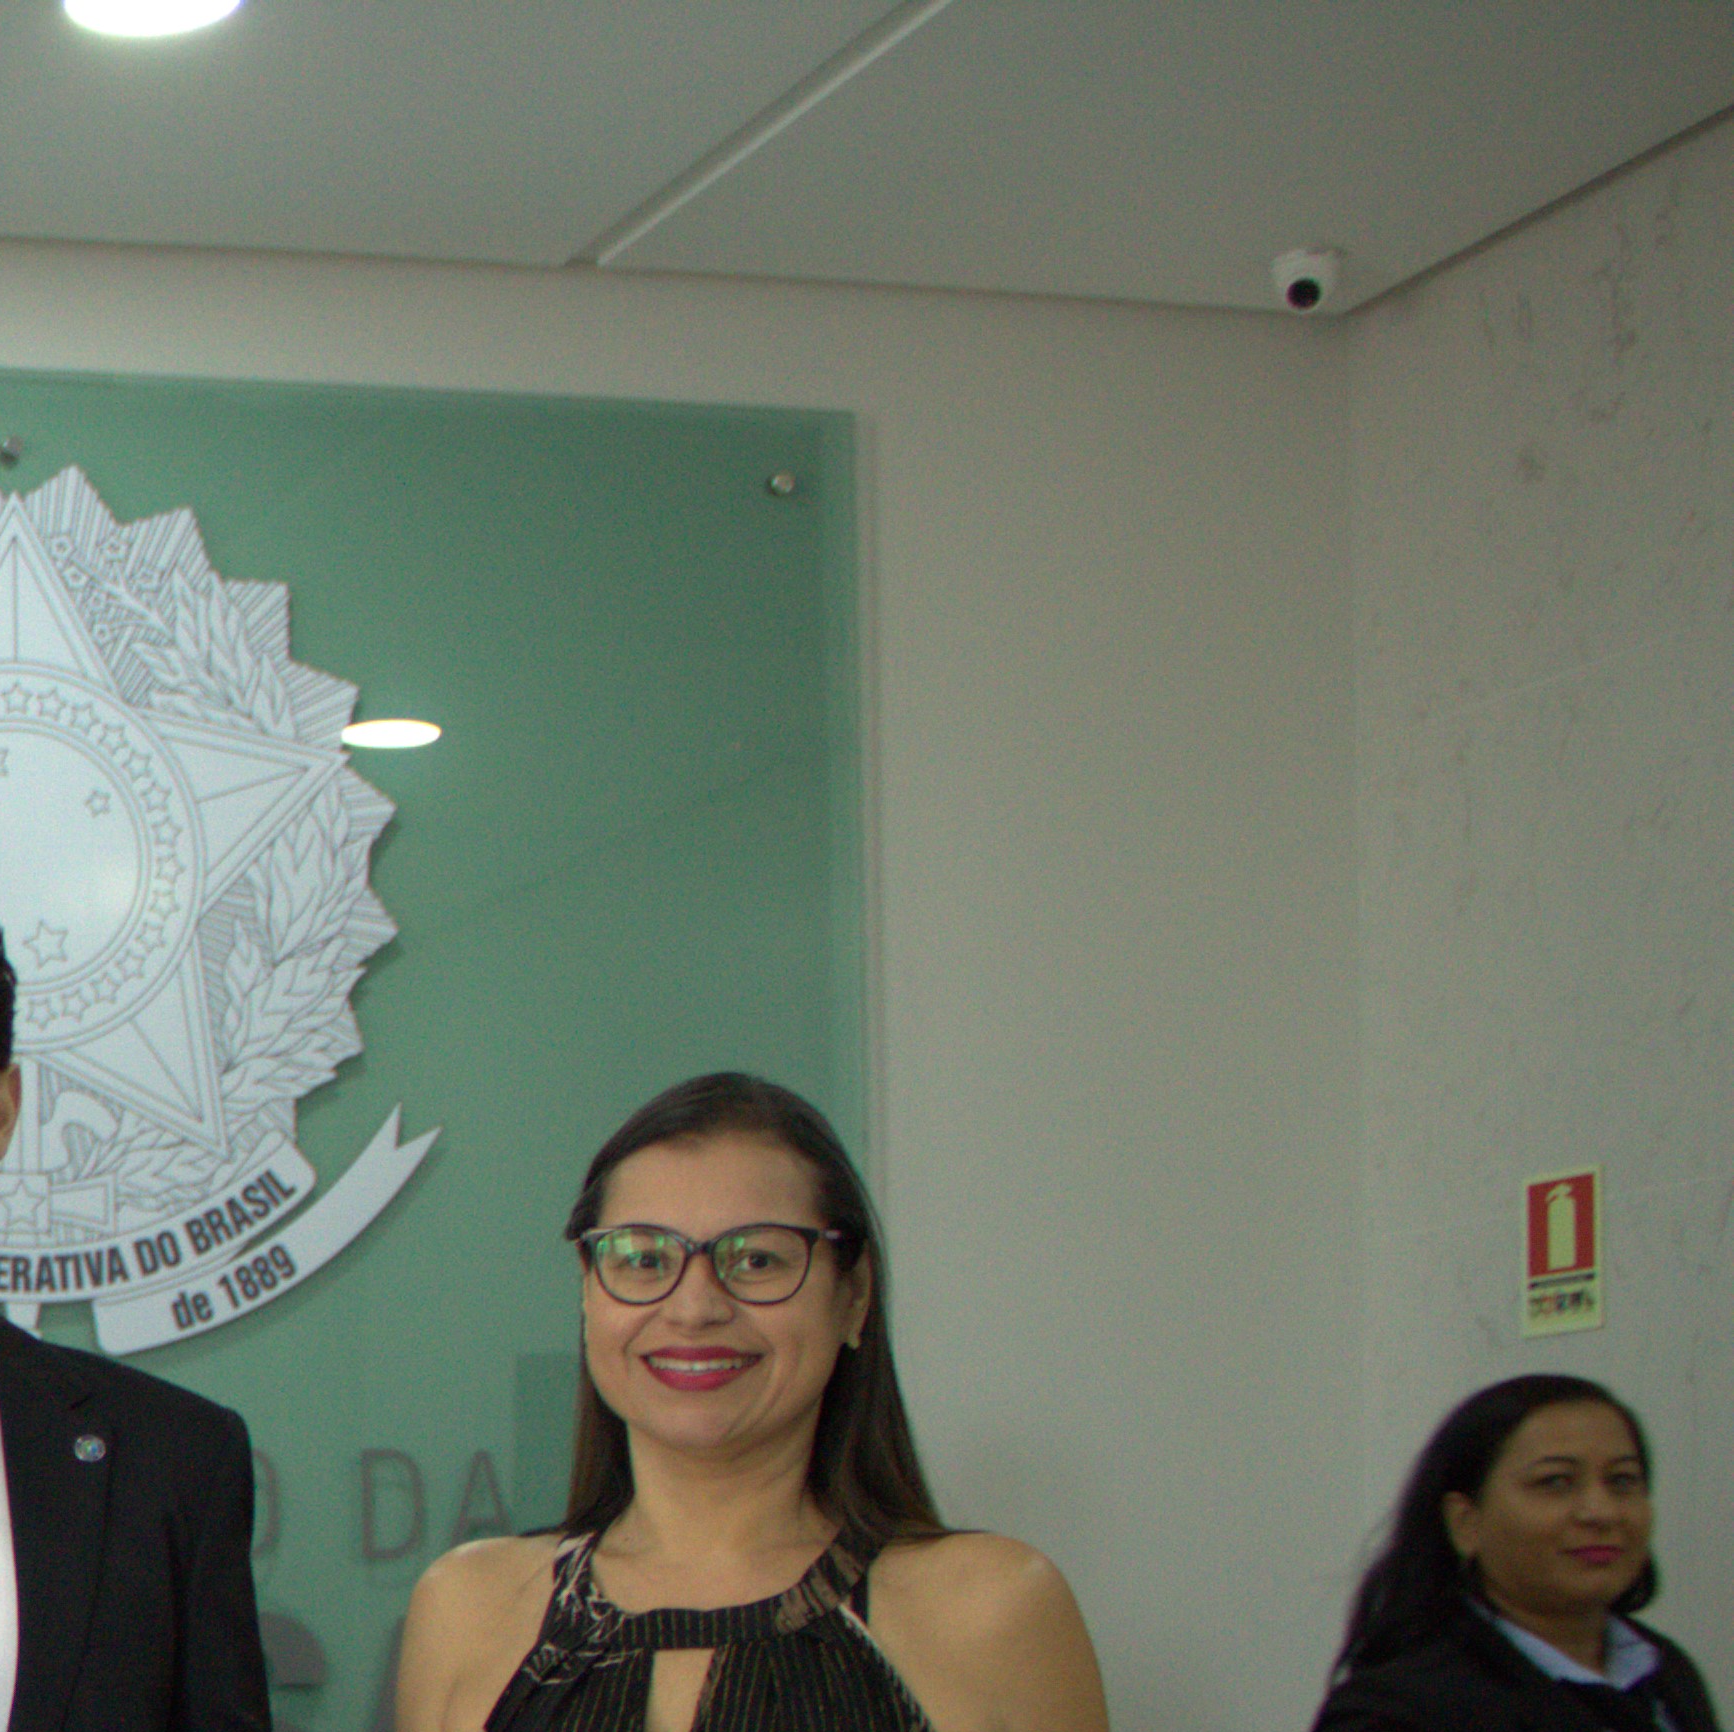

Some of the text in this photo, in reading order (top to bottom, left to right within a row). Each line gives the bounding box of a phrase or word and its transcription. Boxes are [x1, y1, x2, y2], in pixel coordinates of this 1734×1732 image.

[133, 1229, 182, 1276] DO
[185, 1169, 296, 1255] BRASIL
[171, 1244, 298, 1331] de 1889
[361, 1448, 516, 1560] DA
